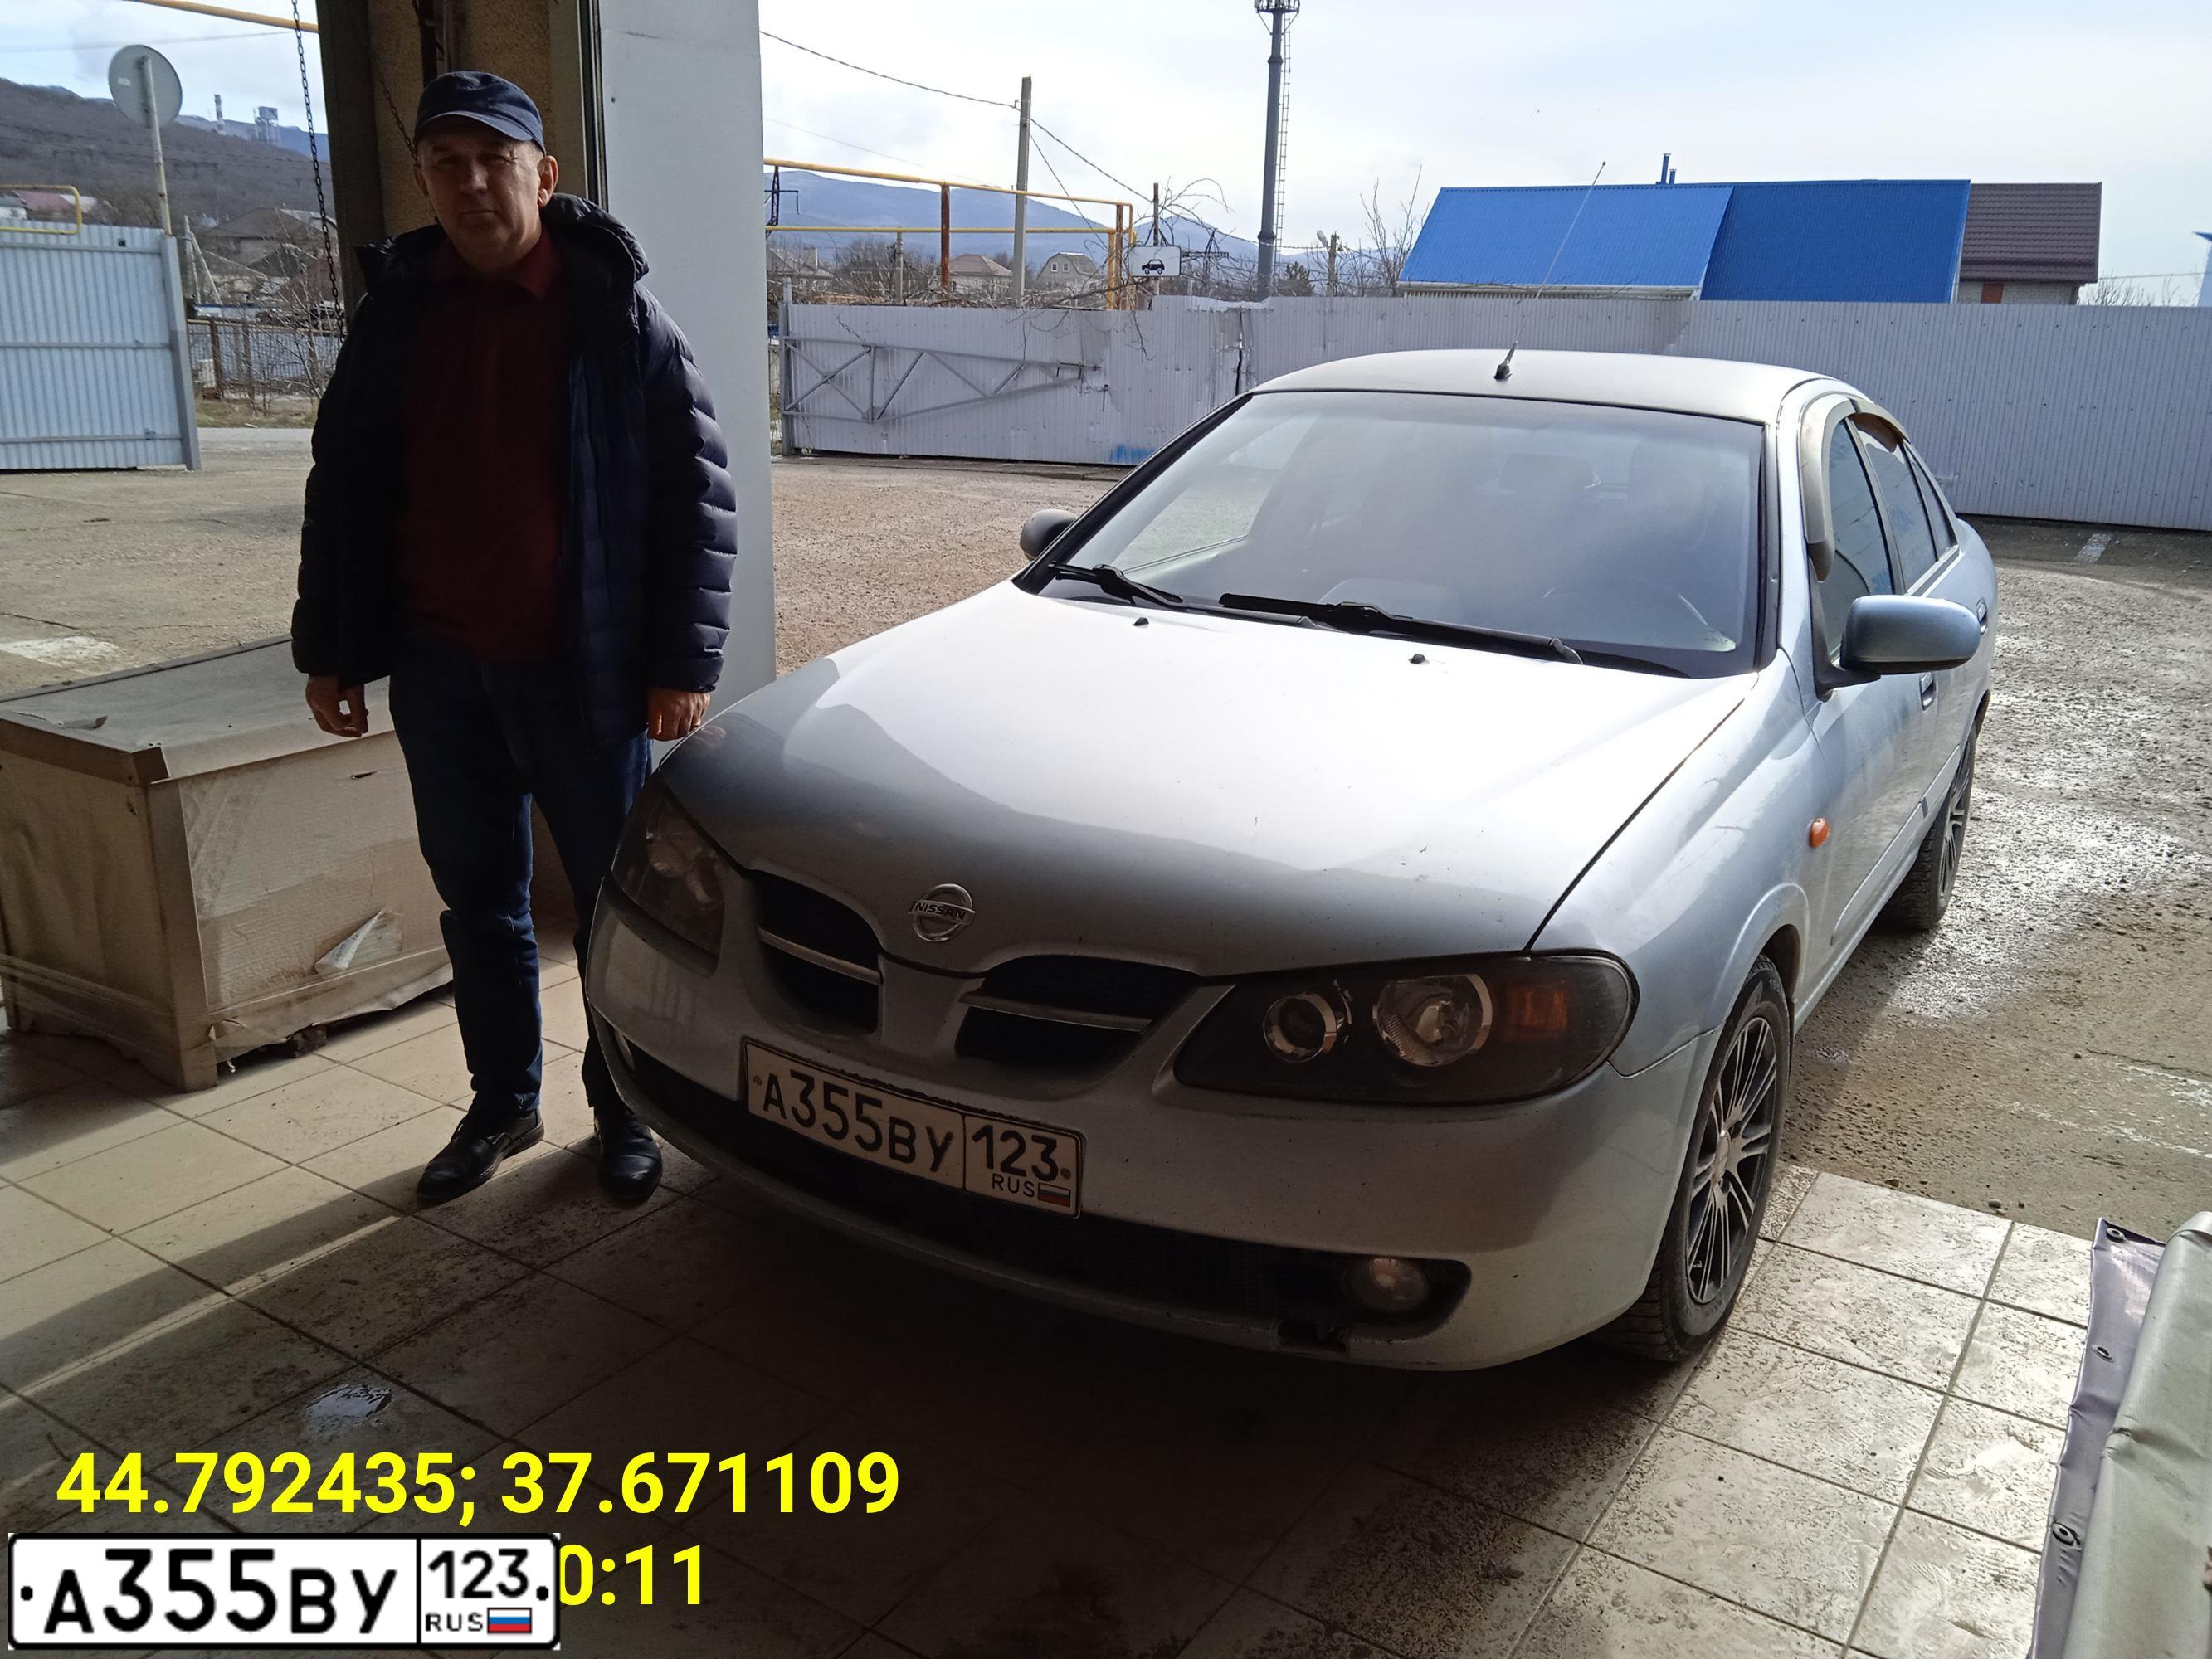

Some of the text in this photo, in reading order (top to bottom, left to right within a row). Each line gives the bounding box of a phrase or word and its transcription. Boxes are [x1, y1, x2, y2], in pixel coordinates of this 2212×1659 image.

[915, 902, 967, 920] NISSAN
[972, 1124, 1059, 1182] 123
[991, 1172, 1035, 1199] RUS
